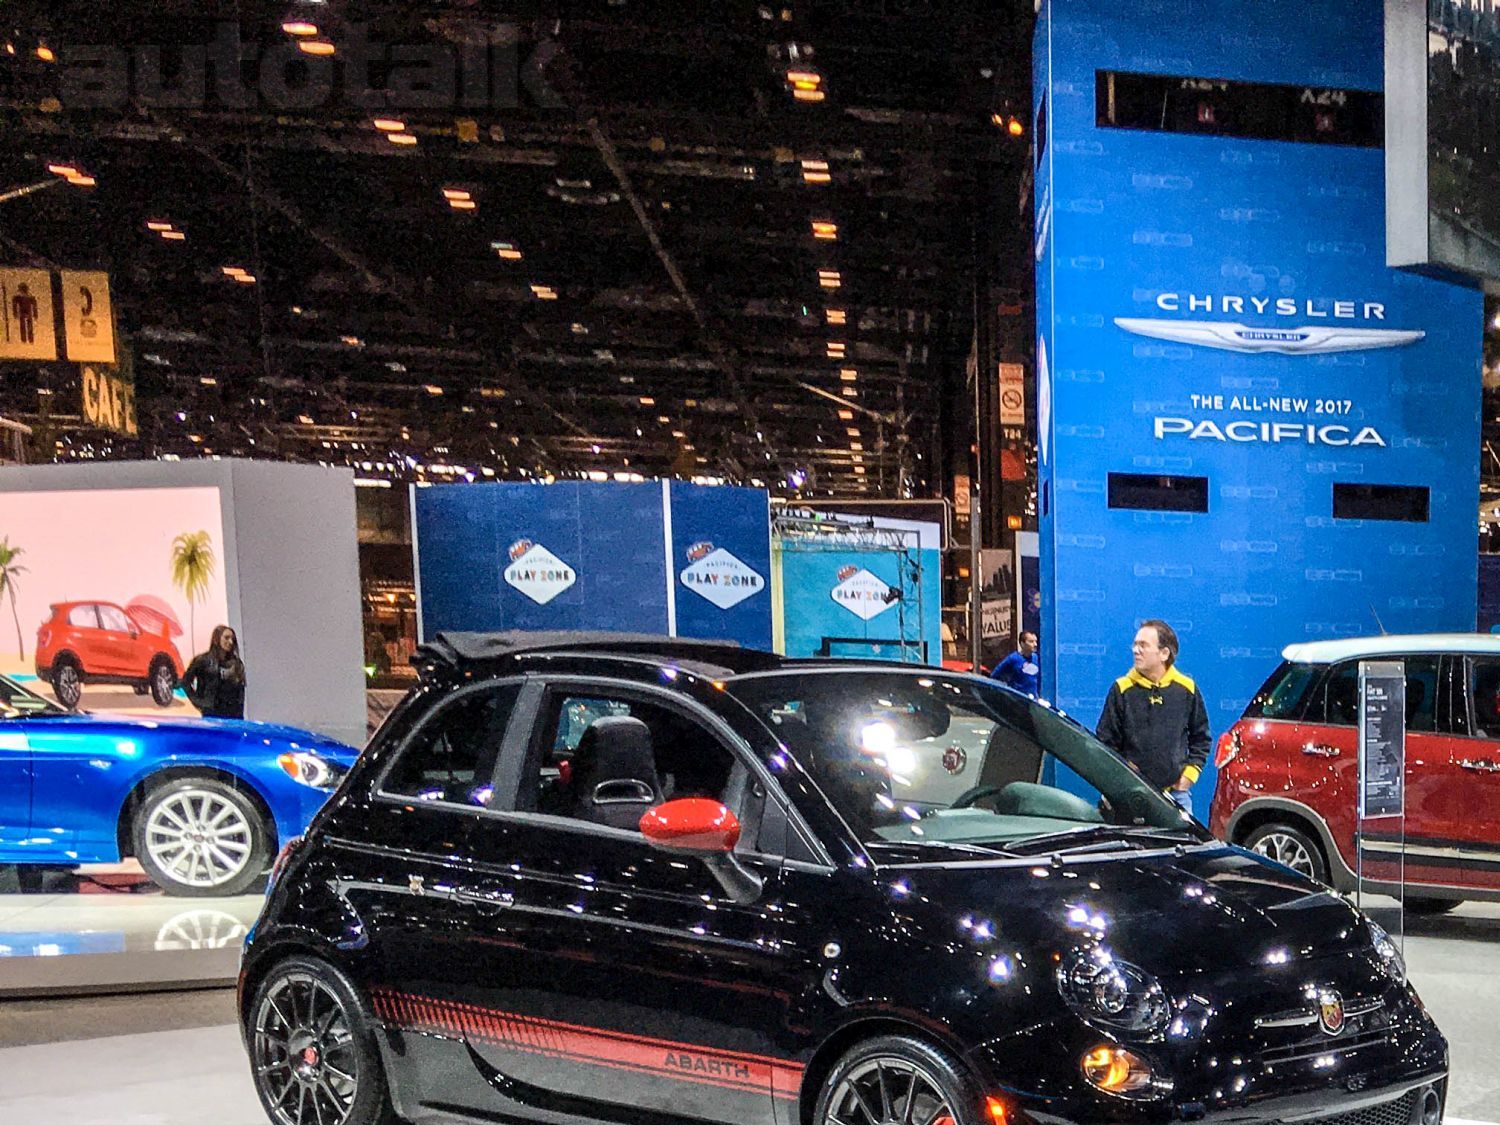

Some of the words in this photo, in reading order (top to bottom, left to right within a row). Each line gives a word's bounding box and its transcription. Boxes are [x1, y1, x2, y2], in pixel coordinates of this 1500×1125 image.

[1156, 293, 1385, 320] CHRYSLER
[84, 366, 138, 434] CAFE
[1191, 394, 1224, 410] THE
[1230, 396, 1308, 413] ALL-NEW
[1314, 399, 1352, 415] 2017
[1154, 416, 1386, 447] PACIFICA
[510, 569, 536, 582] PLAY
[541, 569, 570, 582] ZONE
[688, 572, 718, 585] PLAY
[723, 574, 757, 587] ZONE
[837, 589, 862, 600] PLAY
[866, 591, 889, 601] ZON
[664, 1052, 749, 1078] ABARTH
